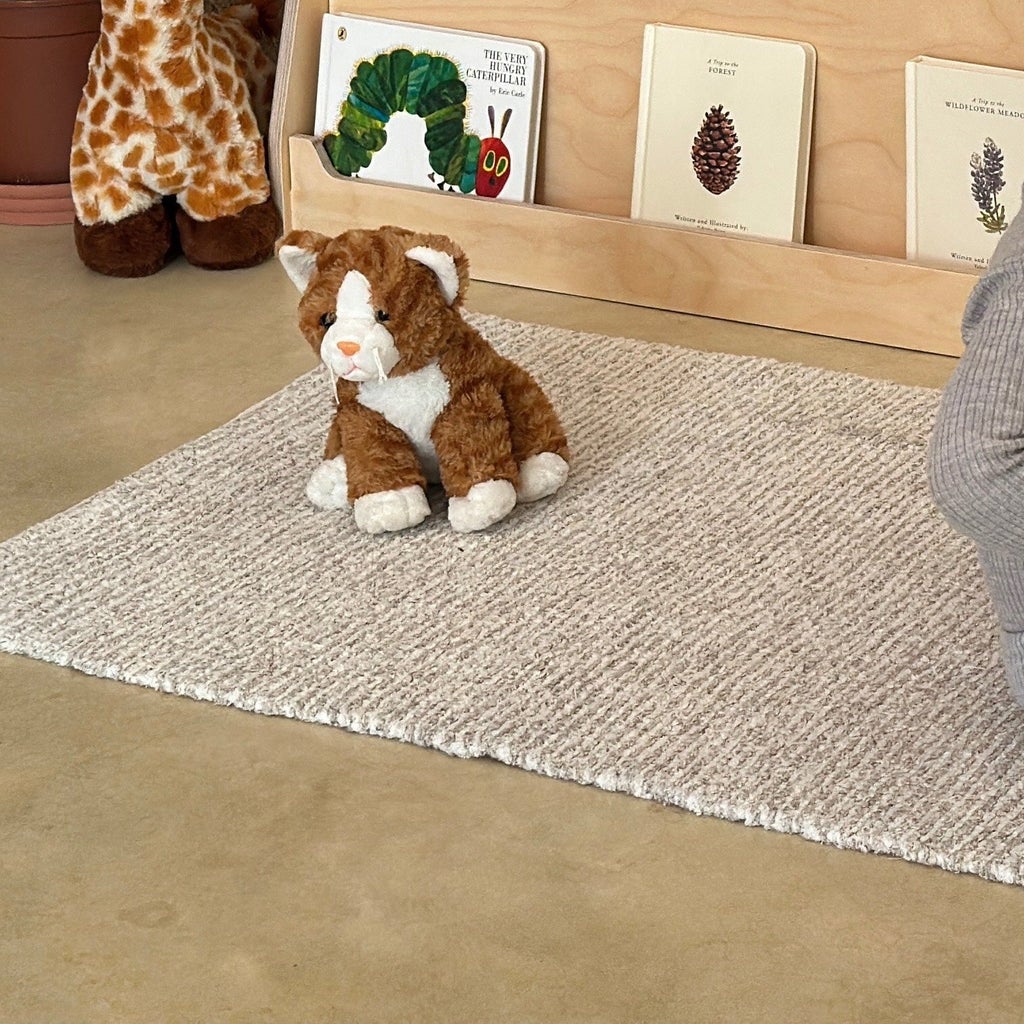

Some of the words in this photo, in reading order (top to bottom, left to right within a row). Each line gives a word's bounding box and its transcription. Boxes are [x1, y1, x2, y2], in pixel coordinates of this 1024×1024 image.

[484, 49, 502, 61] THE
[504, 52, 528, 65] VERY
[490, 61, 527, 76] HUNGRY
[708, 66, 736, 76] FOREST
[466, 68, 526, 86] CATERPILLAR
[490, 86, 497, 95] by
[499, 87, 510, 95] Eric
[511, 89, 525, 97] Carle
[945, 101, 995, 114] WILDFLOWER
[674, 214, 696, 223] Written
[709, 219, 738, 229] Illustrated
